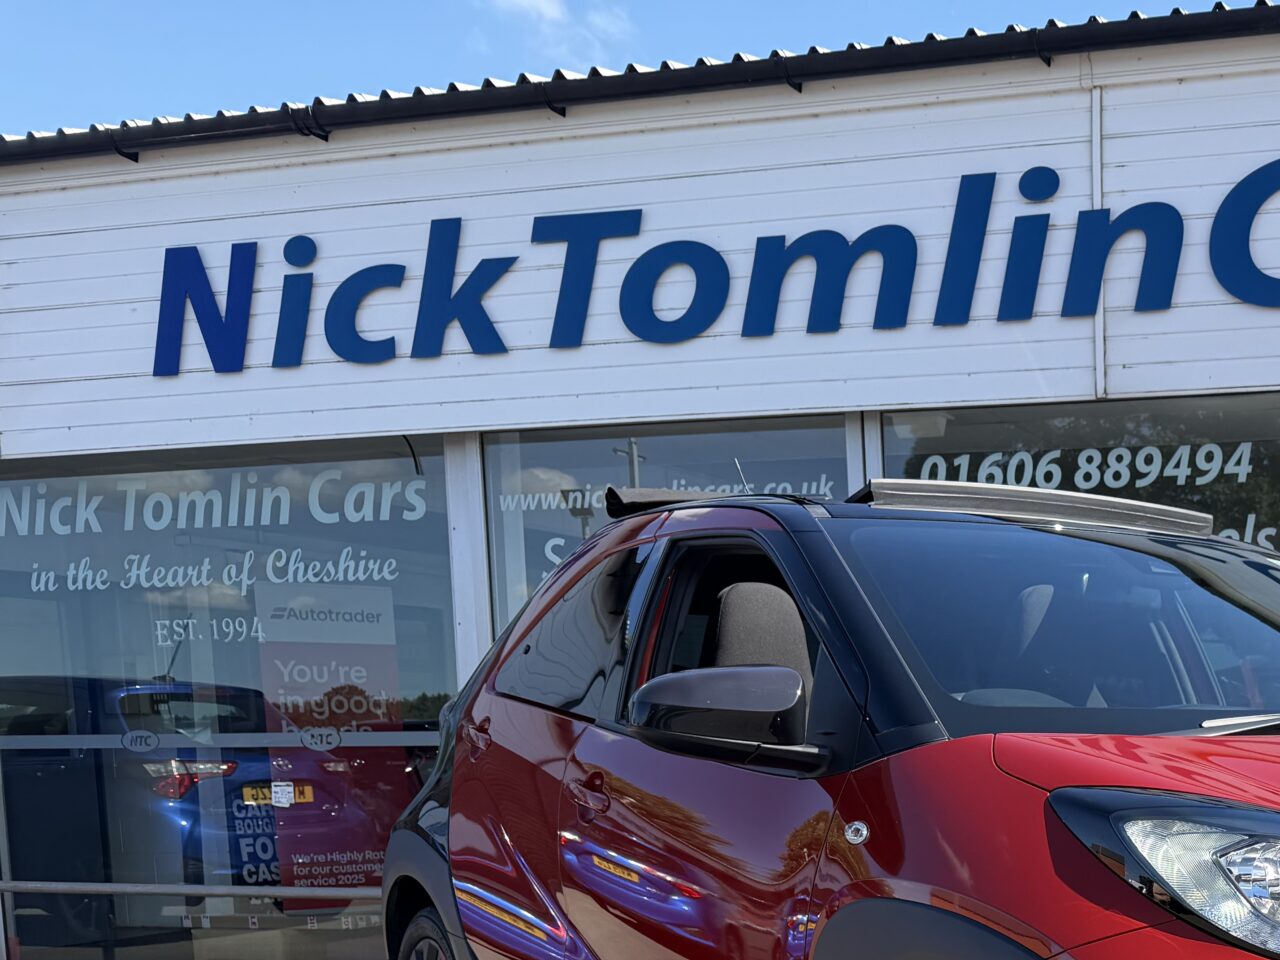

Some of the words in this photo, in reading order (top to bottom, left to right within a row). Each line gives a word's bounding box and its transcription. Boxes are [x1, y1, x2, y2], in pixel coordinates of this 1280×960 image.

[920, 449, 1062, 490] 01606
[1074, 442, 1253, 490] 889494
[0, 481, 104, 537] Nick
[117, 472, 290, 531] Tomlin
[308, 469, 427, 524] Cars
[31, 562, 59, 592] in
[66, 556, 111, 591] the
[120, 553, 214, 589] Heart
[222, 550, 256, 597] of
[265, 546, 400, 584] Cheshire
[286, 607, 382, 624] Autotrader
[155, 618, 203, 646] EST.
[209, 617, 266, 644] 1994
[274, 659, 368, 684] You're
[278, 688, 304, 713] in
[310, 690, 388, 720] good
[129, 735, 151, 747] NTC
[310, 733, 332, 746] NTC
[232, 799, 274, 818] CAR
[235, 819, 275, 835] BOUG
[239, 836, 279, 862] FO
[291, 853, 325, 864] We're
[327, 850, 364, 864] Highly
[365, 850, 385, 860] Rat
[242, 862, 280, 884] CAS
[293, 865, 310, 876] for
[312, 865, 331, 875] our
[332, 863, 384, 874] custome
[294, 876, 336, 887] service
[338, 874, 366, 884] 2025
